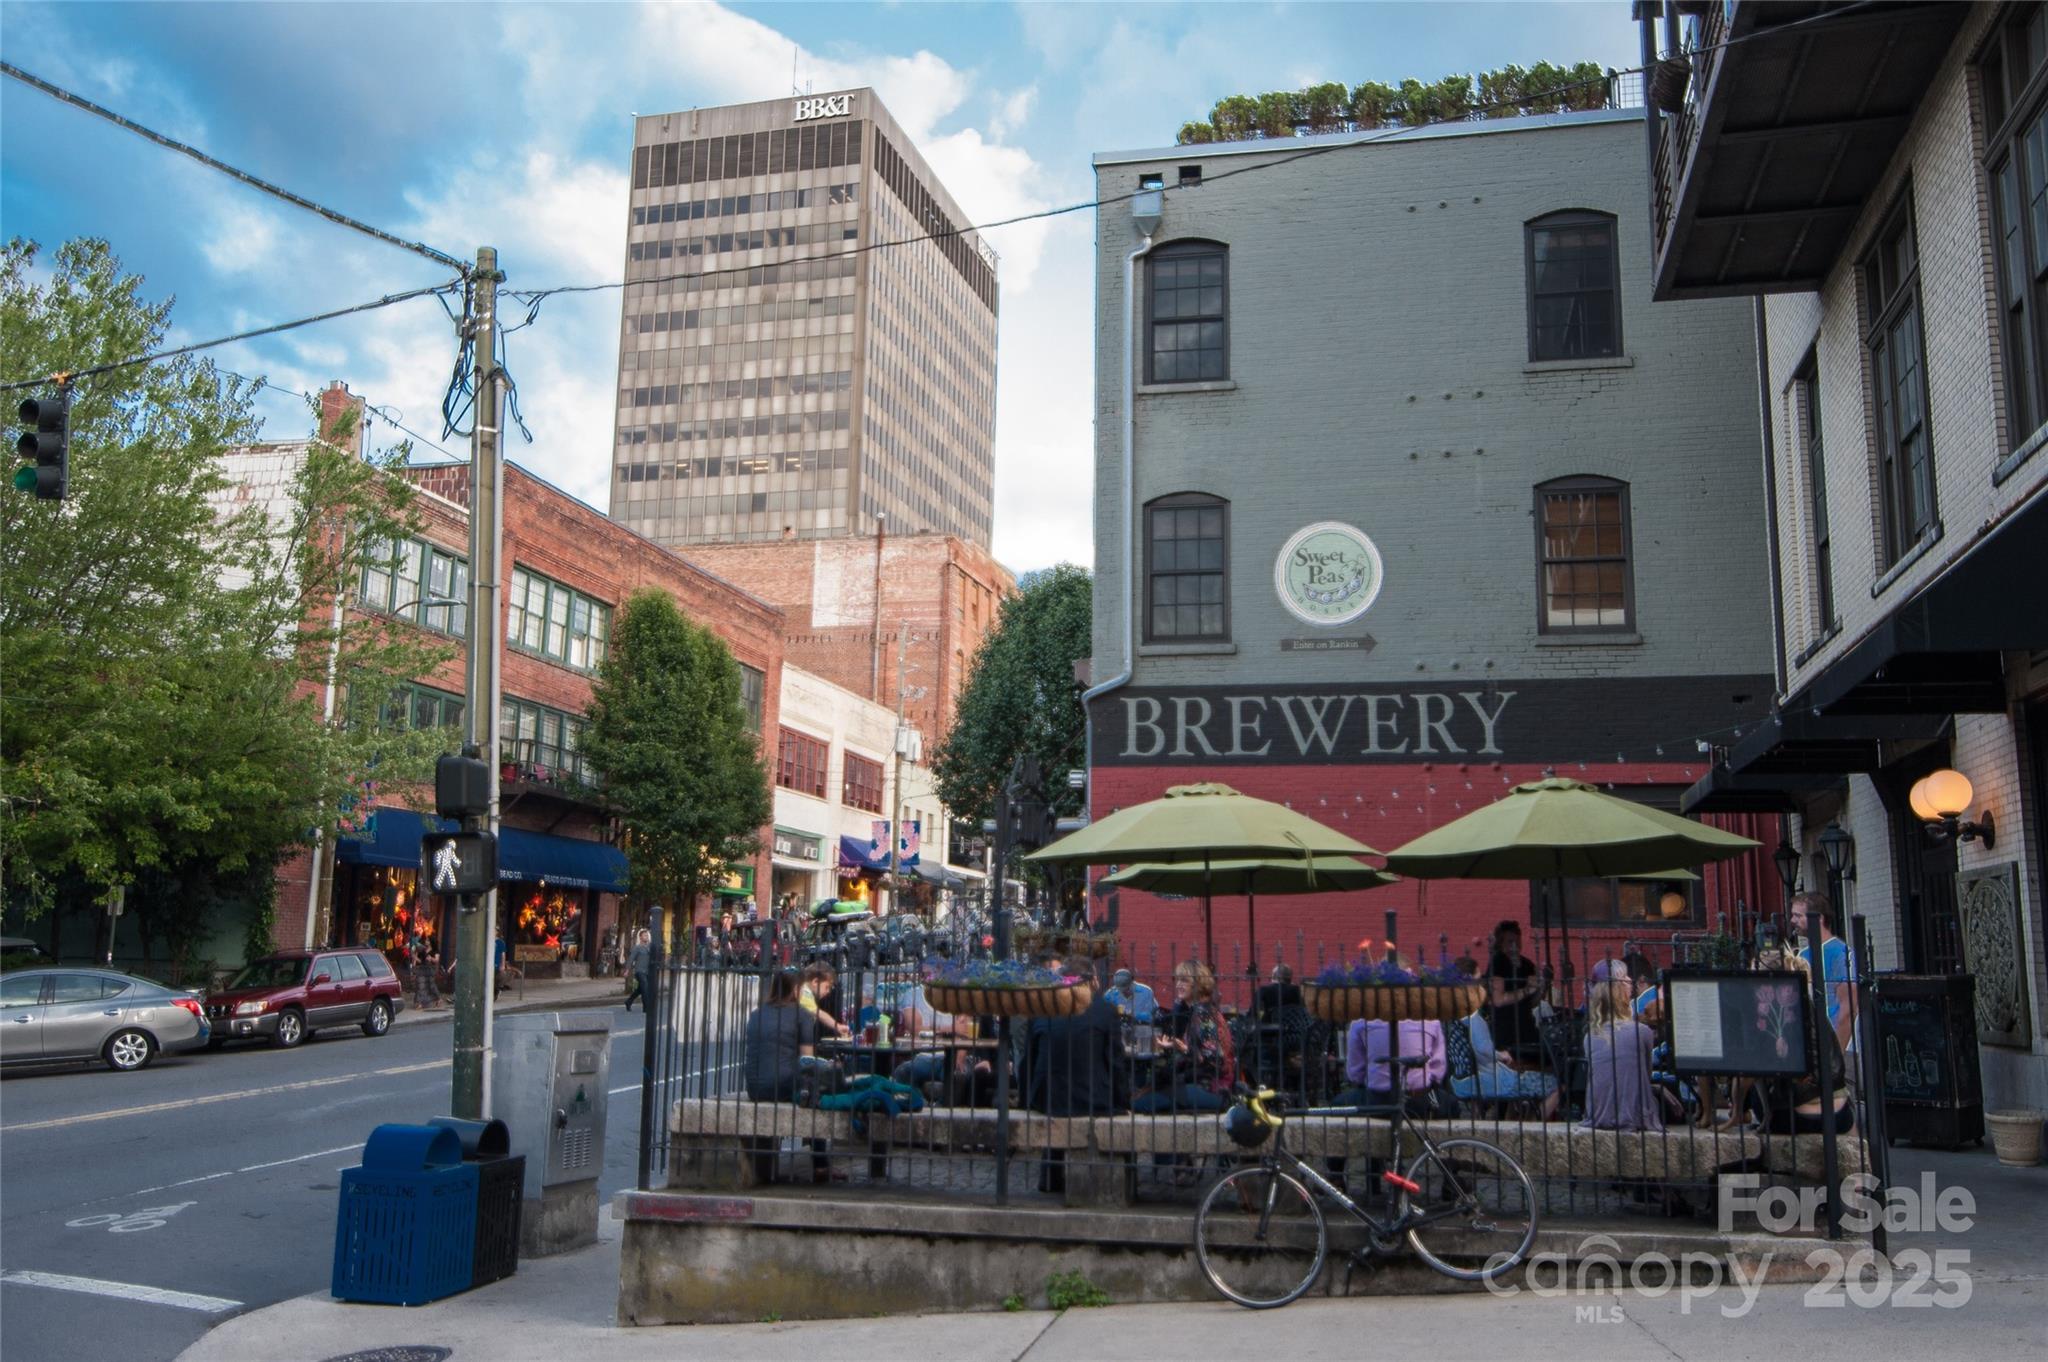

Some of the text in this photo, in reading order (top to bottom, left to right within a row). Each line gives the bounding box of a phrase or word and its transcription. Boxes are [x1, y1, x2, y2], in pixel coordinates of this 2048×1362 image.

[793, 94, 855, 121] BB&T
[1295, 547, 1346, 567] Sweet
[1308, 565, 1345, 585] Peas
[1293, 639, 1359, 649] Enter on Rankin
[1119, 691, 1518, 757] BREWERY
